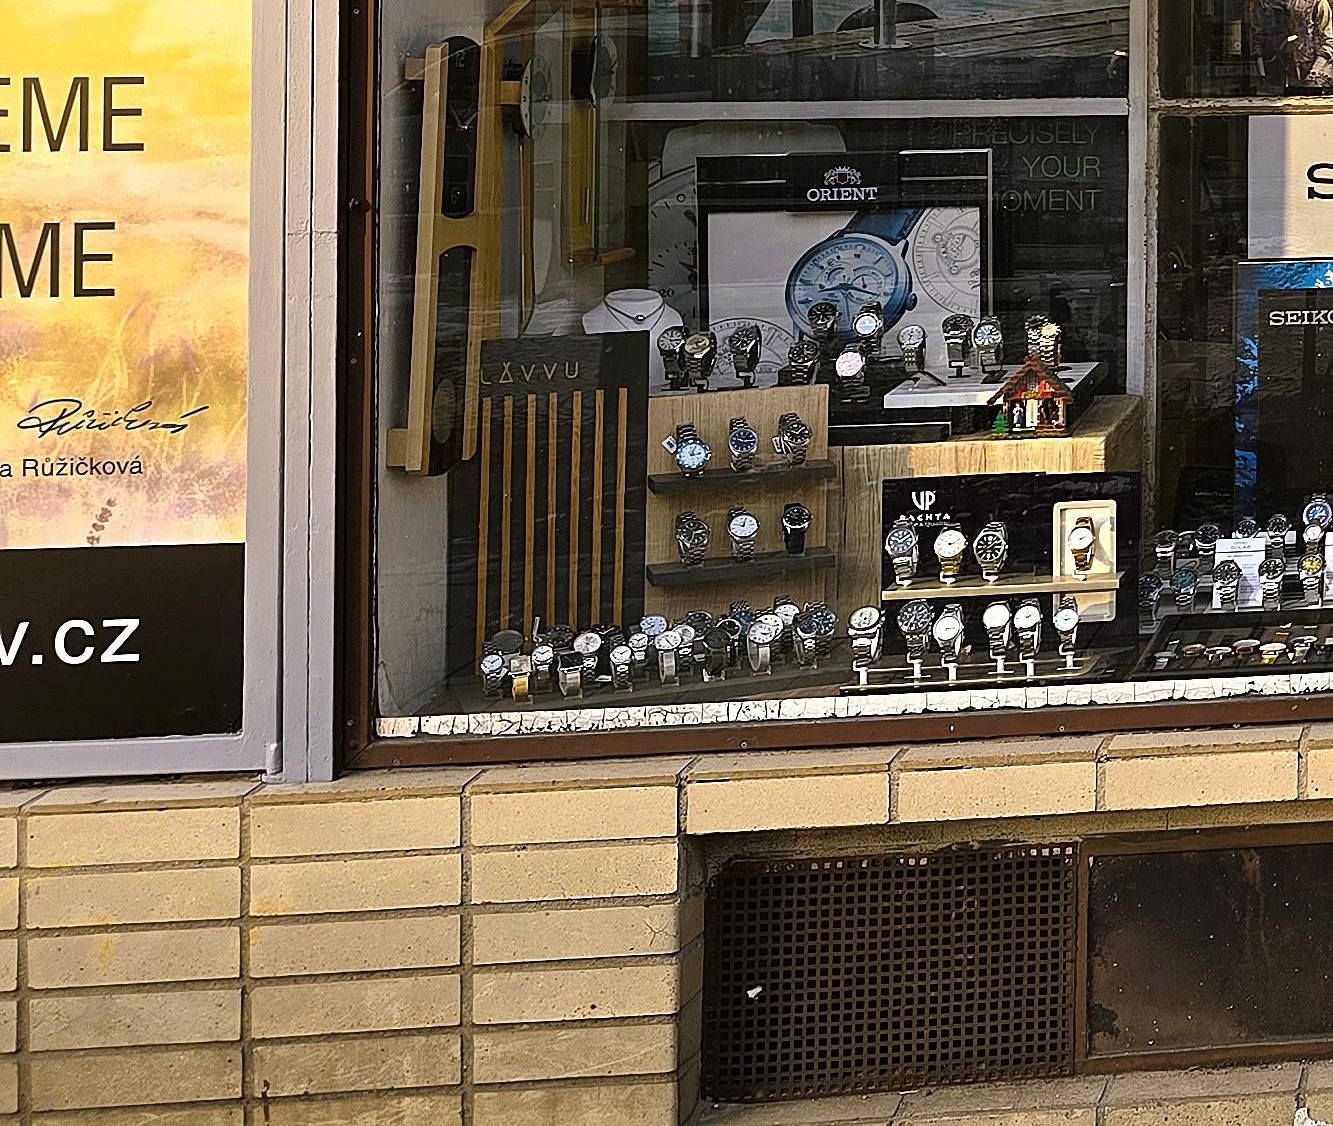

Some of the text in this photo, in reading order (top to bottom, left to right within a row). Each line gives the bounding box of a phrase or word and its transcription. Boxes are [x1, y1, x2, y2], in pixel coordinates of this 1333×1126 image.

[1023, 155, 1101, 178] YOUR
[806, 184, 879, 203] ORIENT
[23, 455, 144, 478] Růžičková
